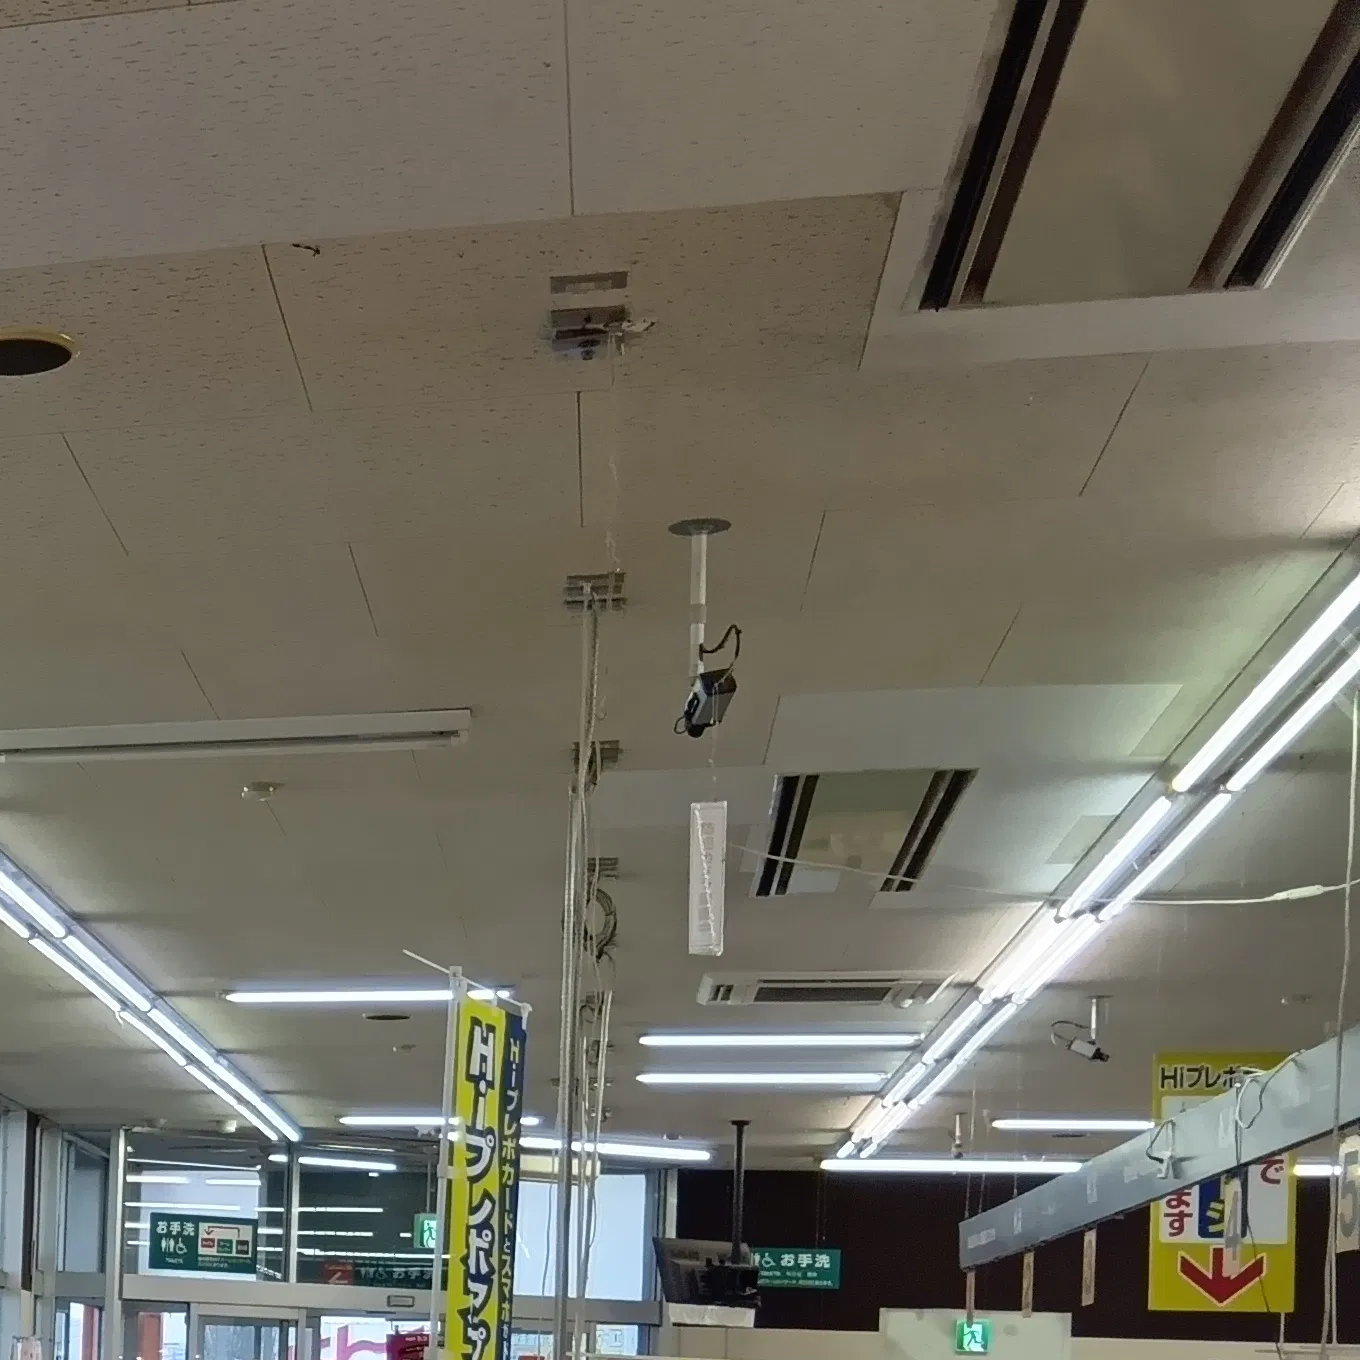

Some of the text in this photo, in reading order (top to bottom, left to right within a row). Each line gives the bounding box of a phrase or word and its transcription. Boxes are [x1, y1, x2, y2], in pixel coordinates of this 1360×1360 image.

[156, 1220, 195, 1236] お手洗
[781, 1253, 831, 1268] お手洗
